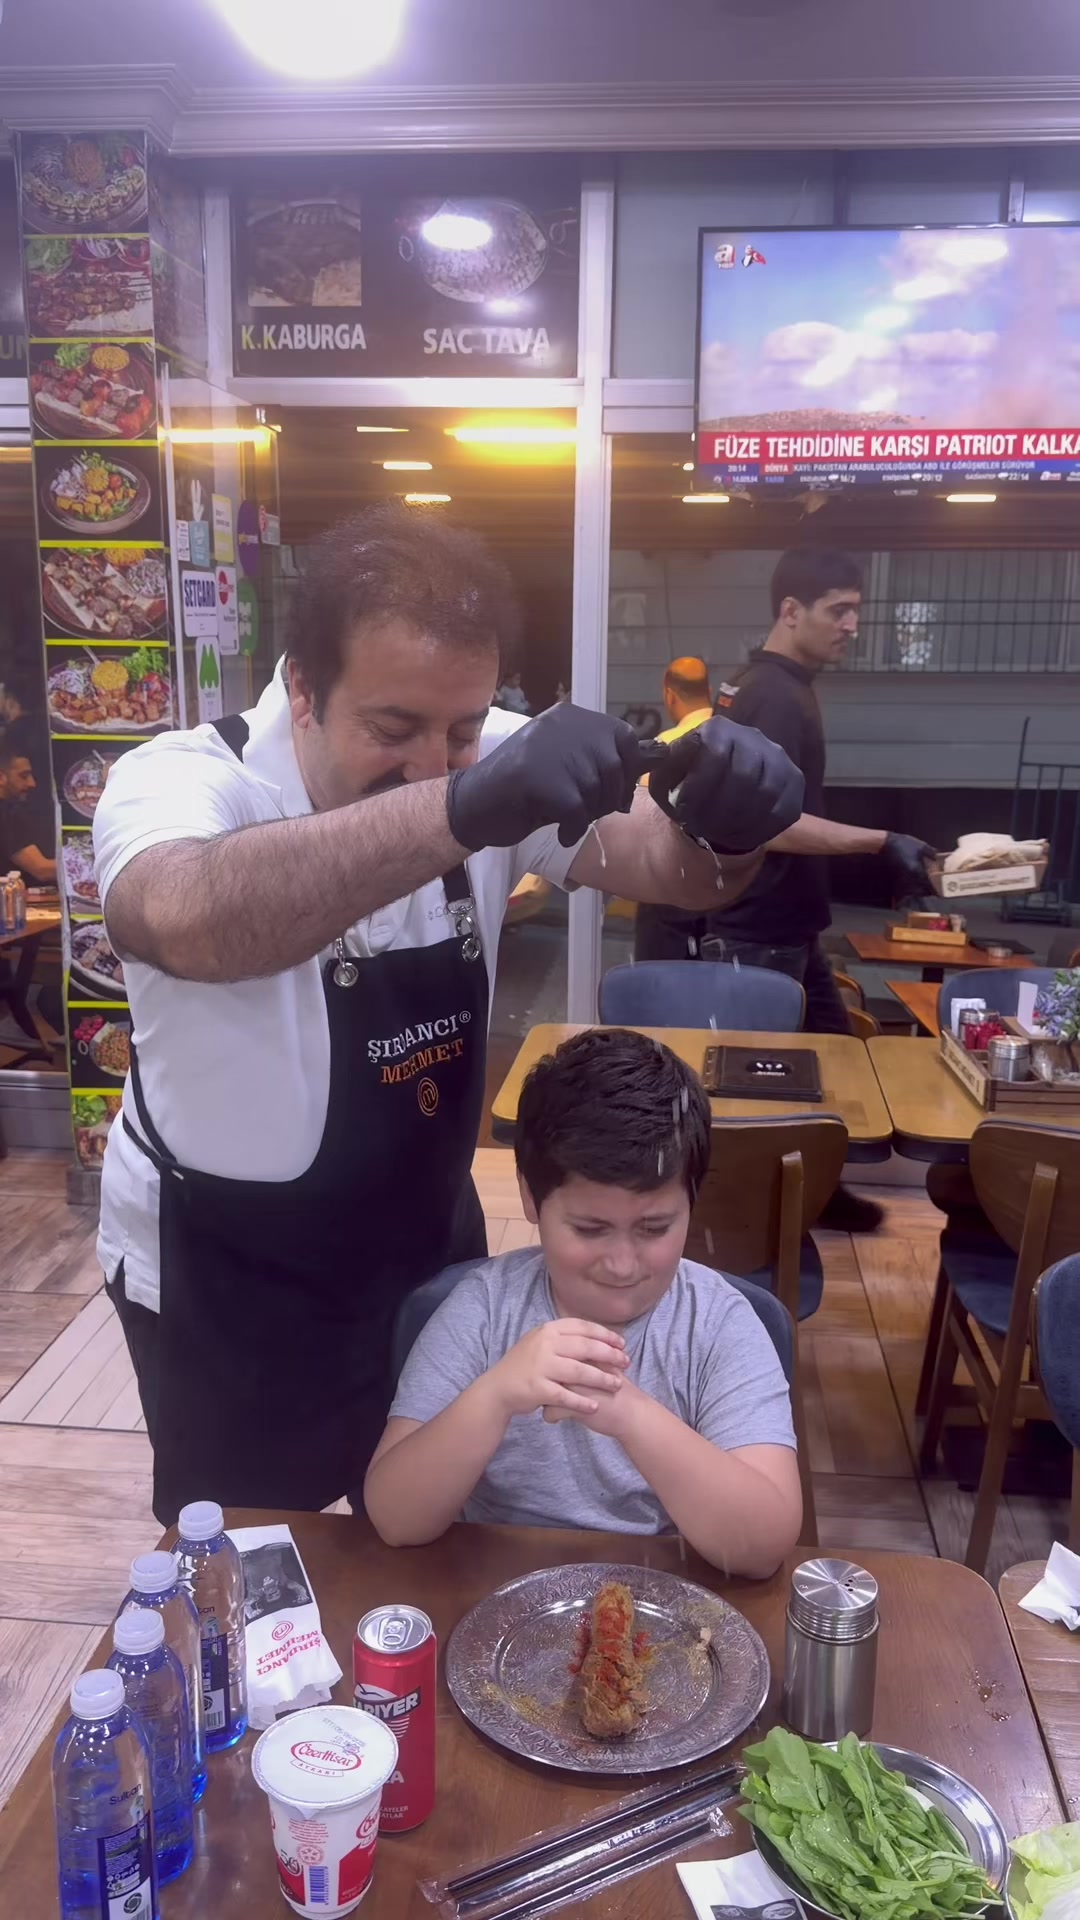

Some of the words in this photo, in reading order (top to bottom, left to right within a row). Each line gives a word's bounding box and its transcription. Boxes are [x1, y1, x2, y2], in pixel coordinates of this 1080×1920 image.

[241, 323, 366, 350] K.KABURGA
[423, 327, 473, 354] SAC
[481, 327, 550, 355] TAVA
[714, 434, 760, 459] FÜZE
[766, 433, 865, 458] TEHDİDİNE
[871, 434, 929, 458] KARŞI
[935, 433, 1017, 456] PATRIOT
[184, 578, 216, 608] SETCARD
[109, 1783, 142, 1805] Sultan
